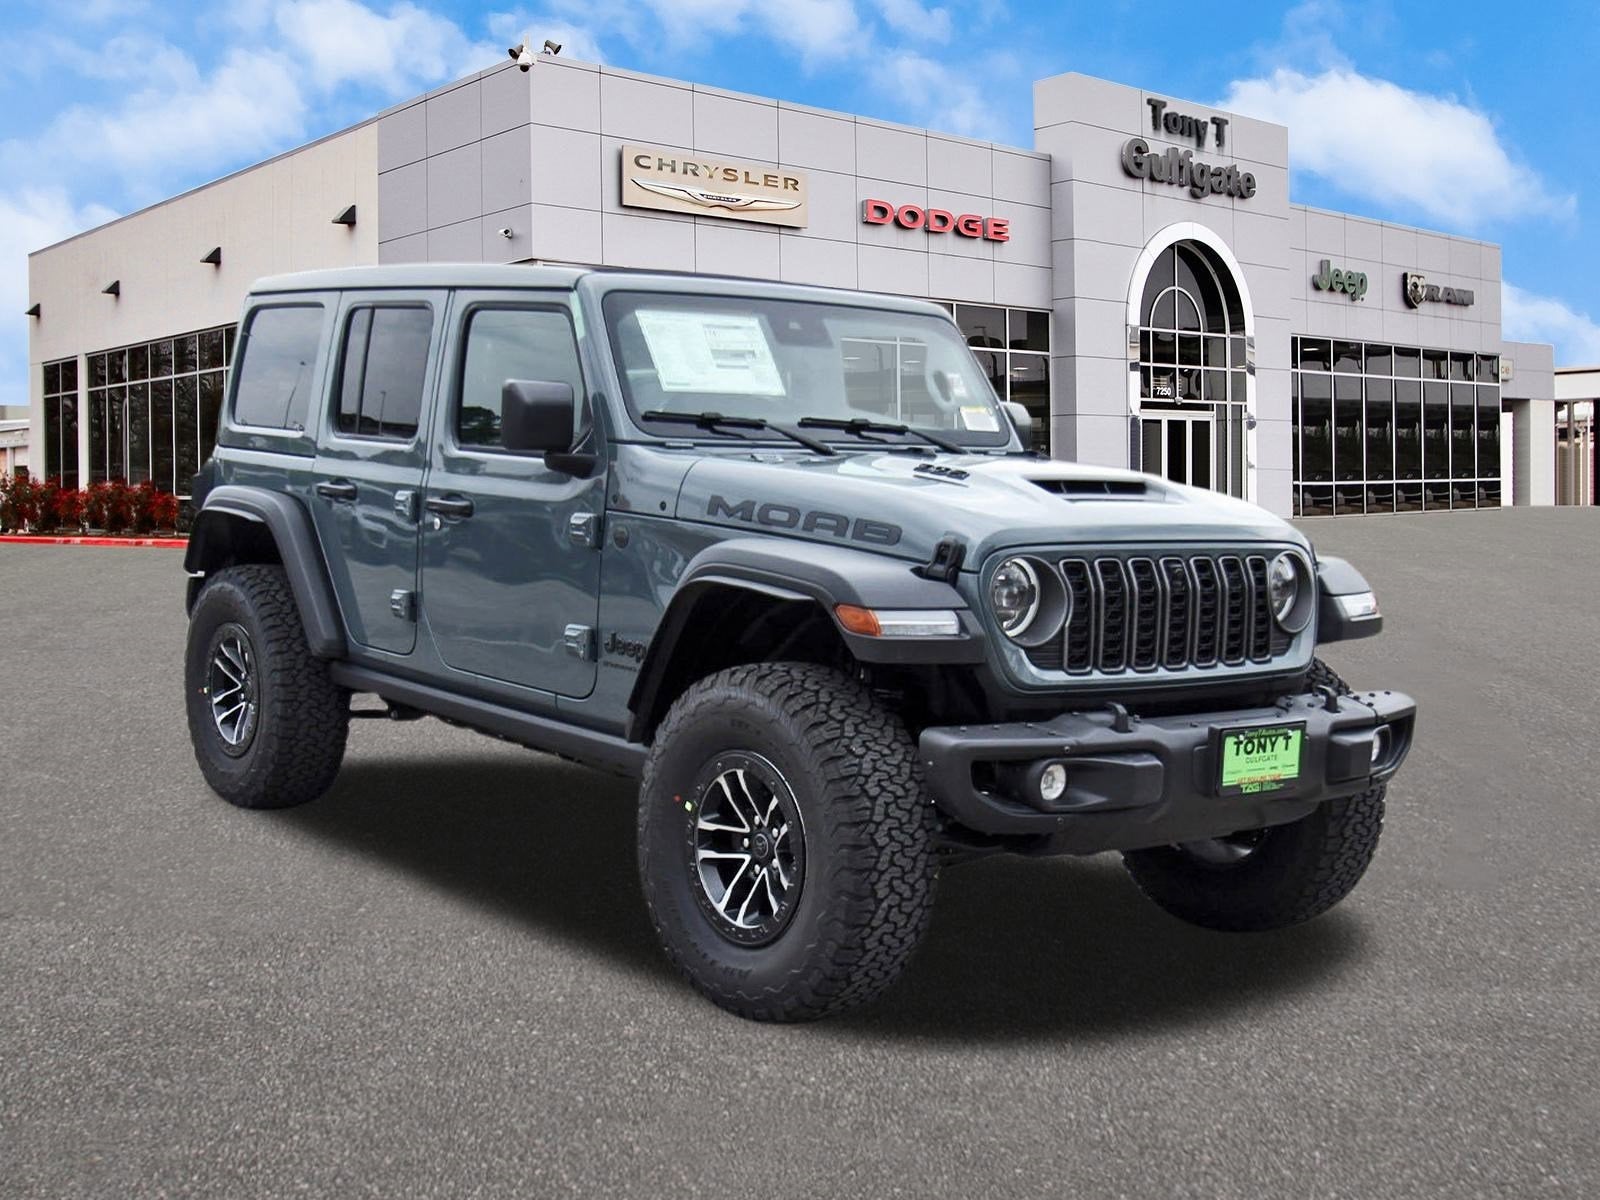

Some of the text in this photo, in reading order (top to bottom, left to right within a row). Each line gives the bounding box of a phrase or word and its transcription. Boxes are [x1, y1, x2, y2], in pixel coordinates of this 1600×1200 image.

[1146, 98, 1229, 148] Tony T
[633, 154, 800, 192] CHRYSLER
[1121, 138, 1257, 199] Gulfgate
[862, 199, 1010, 242] DODGE
[1312, 259, 1368, 301] Jeep
[1424, 284, 1475, 306] RAM
[1156, 386, 1172, 396] 7250
[706, 494, 903, 546] MOAB
[604, 632, 647, 664] Jeep
[1233, 735, 1292, 756] TONY T
